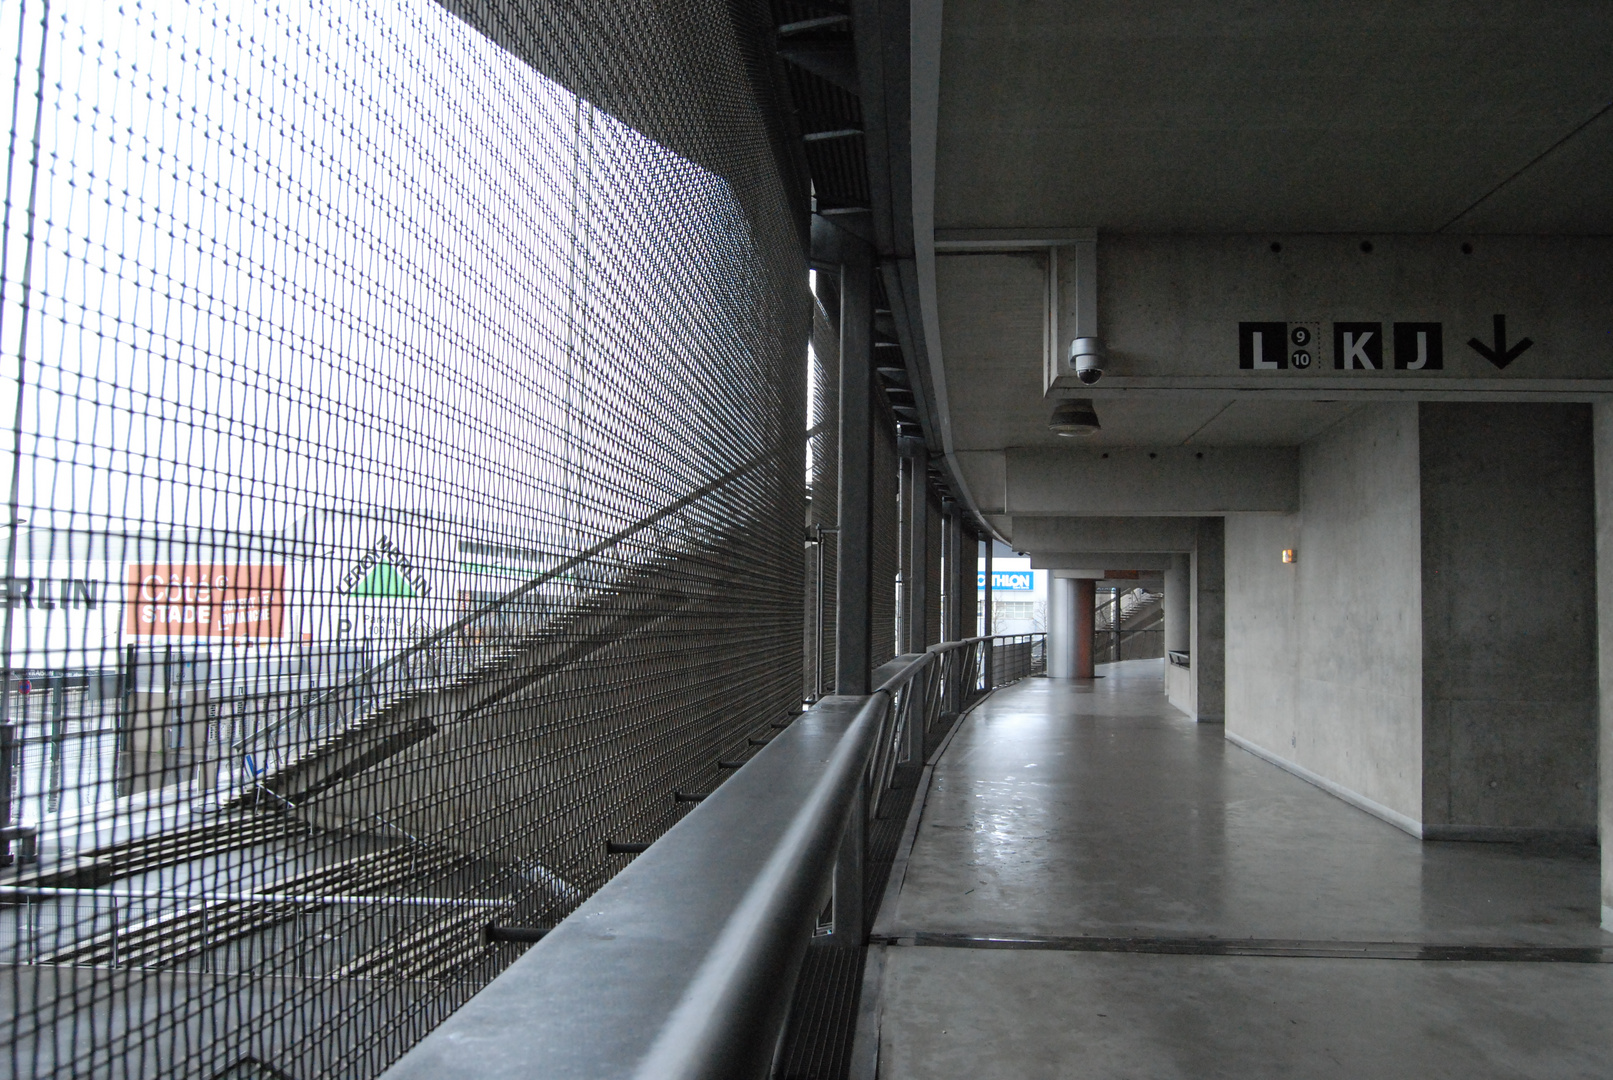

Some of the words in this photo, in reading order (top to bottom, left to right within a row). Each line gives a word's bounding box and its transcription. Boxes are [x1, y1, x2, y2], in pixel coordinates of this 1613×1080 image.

[1295, 331, 1306, 343] 9
[1252, 331, 1278, 370] L
[1343, 331, 1376, 370] K
[1406, 331, 1427, 370] J
[1293, 353, 1309, 366] 10
[142, 573, 210, 602] Côté
[142, 604, 211, 624] STADE
[364, 614, 403, 627] Parkng
